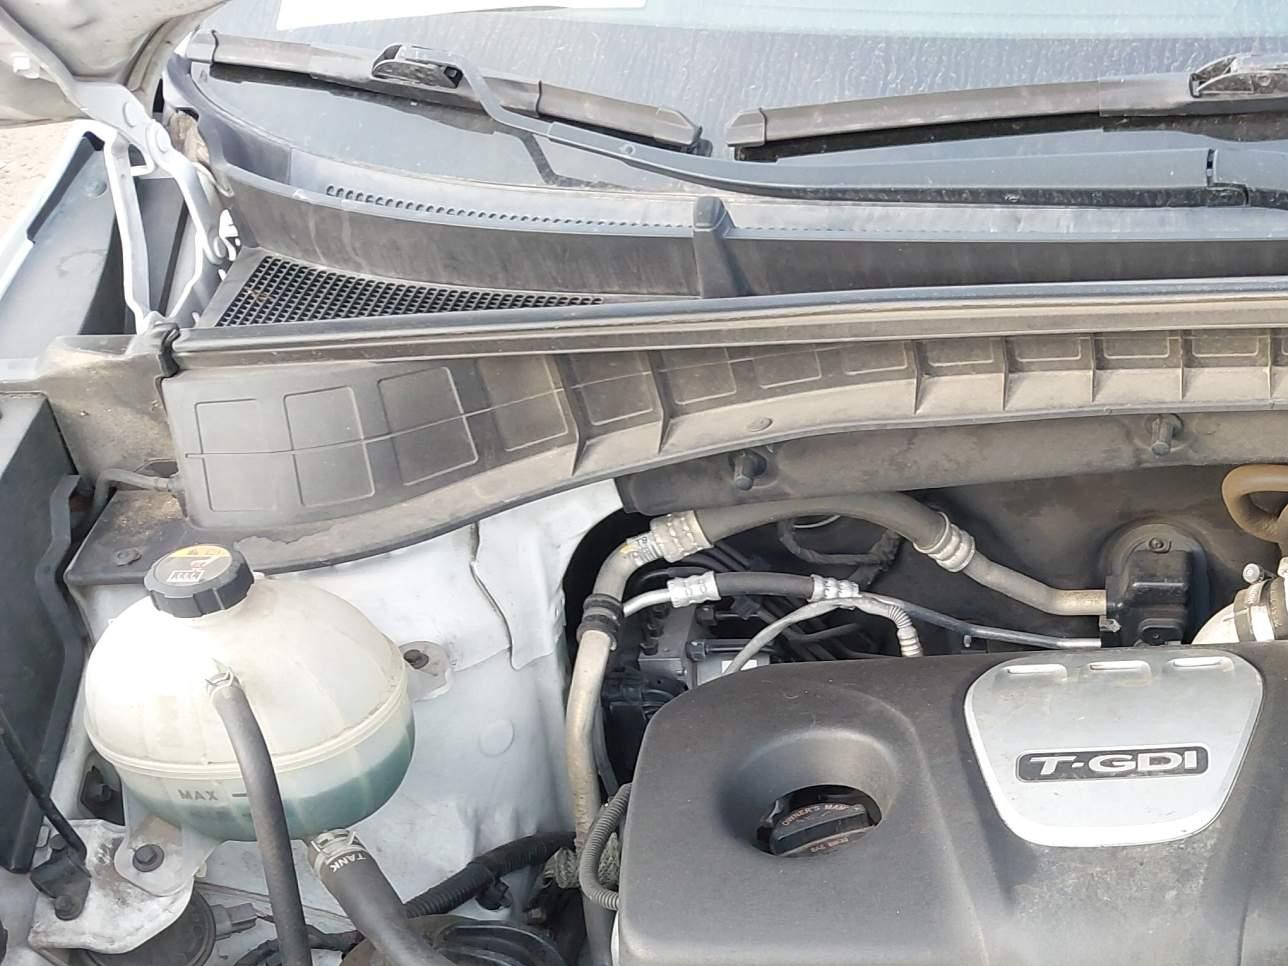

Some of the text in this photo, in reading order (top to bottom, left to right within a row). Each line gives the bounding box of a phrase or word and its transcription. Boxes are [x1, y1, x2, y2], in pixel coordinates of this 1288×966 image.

[1030, 750, 1199, 775] T-GDI
[177, 789, 219, 801] MAX
[329, 852, 367, 873] TANK
